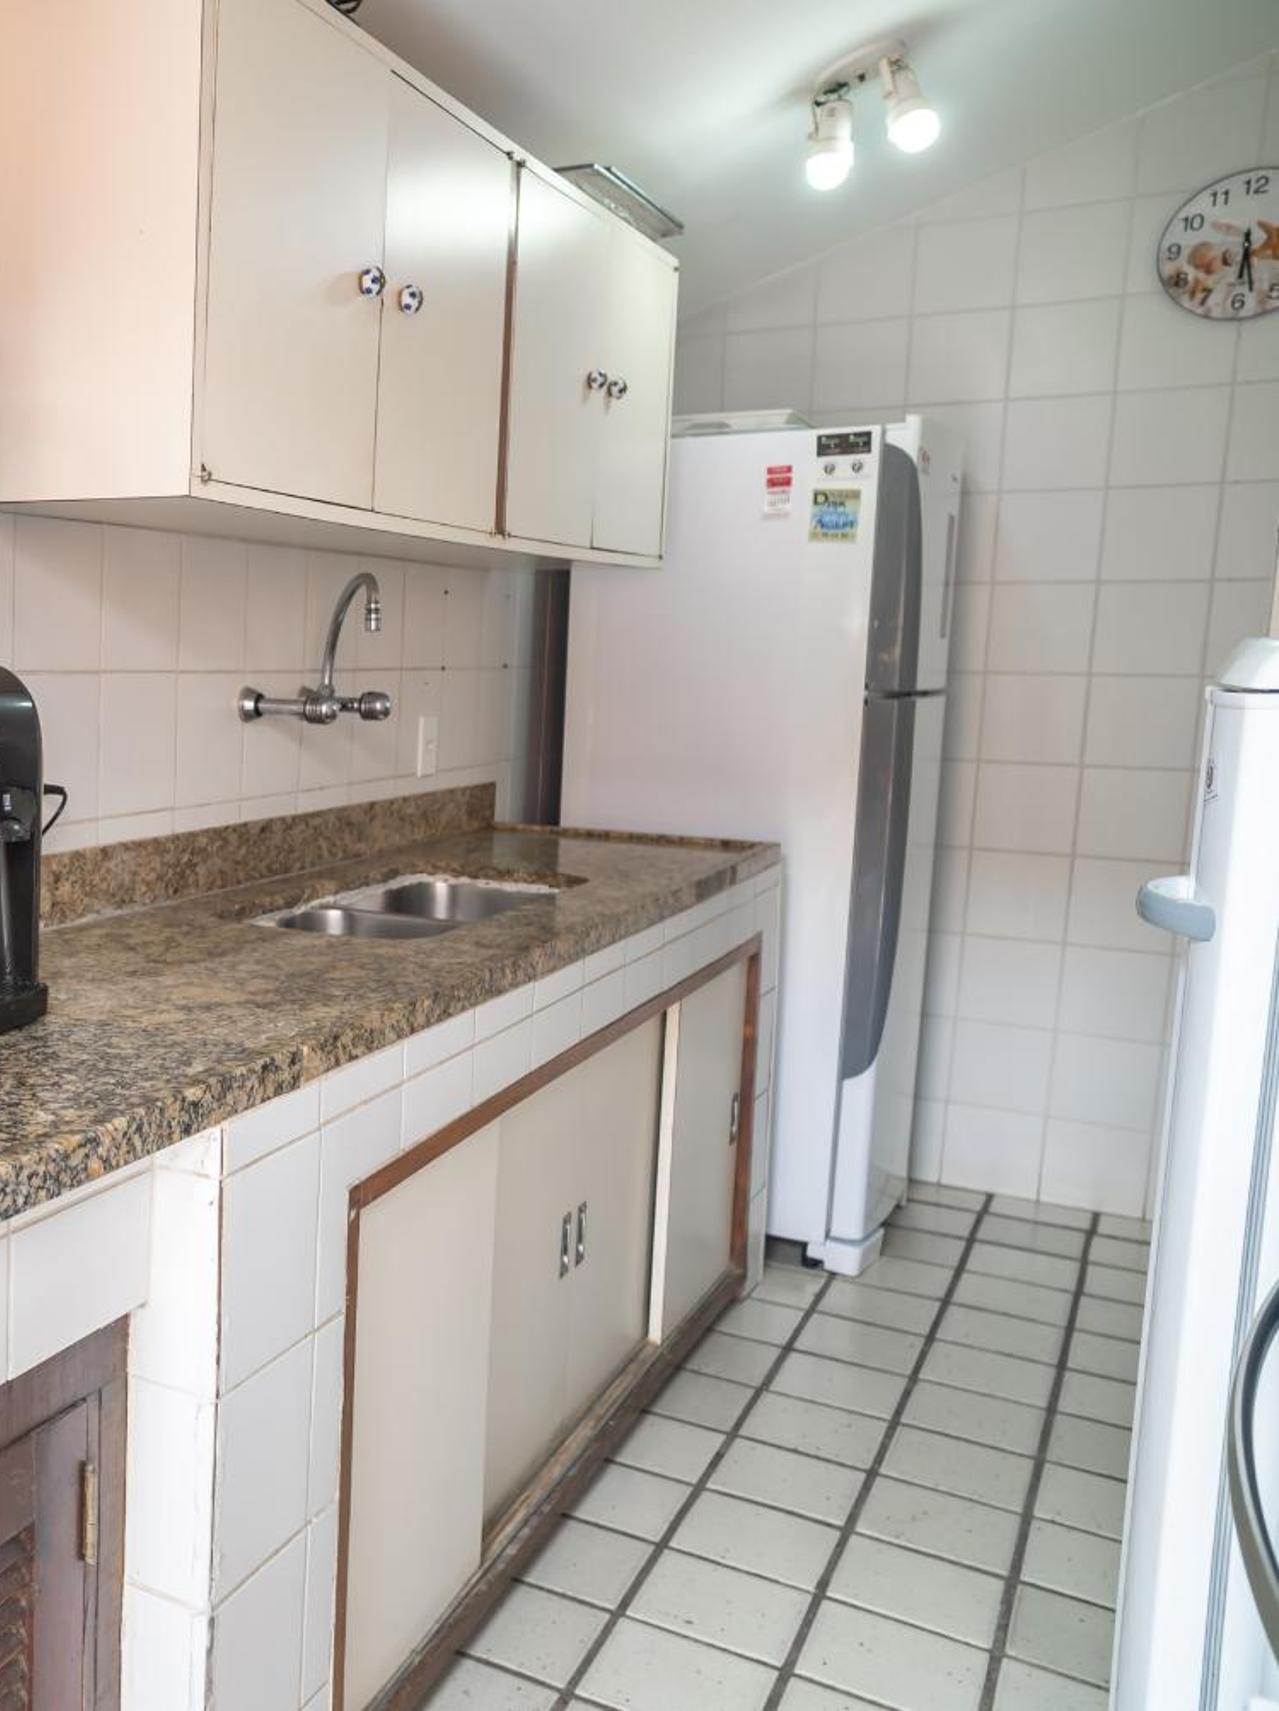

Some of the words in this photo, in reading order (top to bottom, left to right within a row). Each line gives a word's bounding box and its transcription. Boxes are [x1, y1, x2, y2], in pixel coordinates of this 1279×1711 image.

[1243, 176, 1269, 195] 12
[1210, 189, 1230, 207] 11
[1181, 213, 1205, 232] 10
[1167, 243, 1181, 261] 9
[1199, 287, 1213, 306] 7
[1231, 293, 1246, 310] 6
